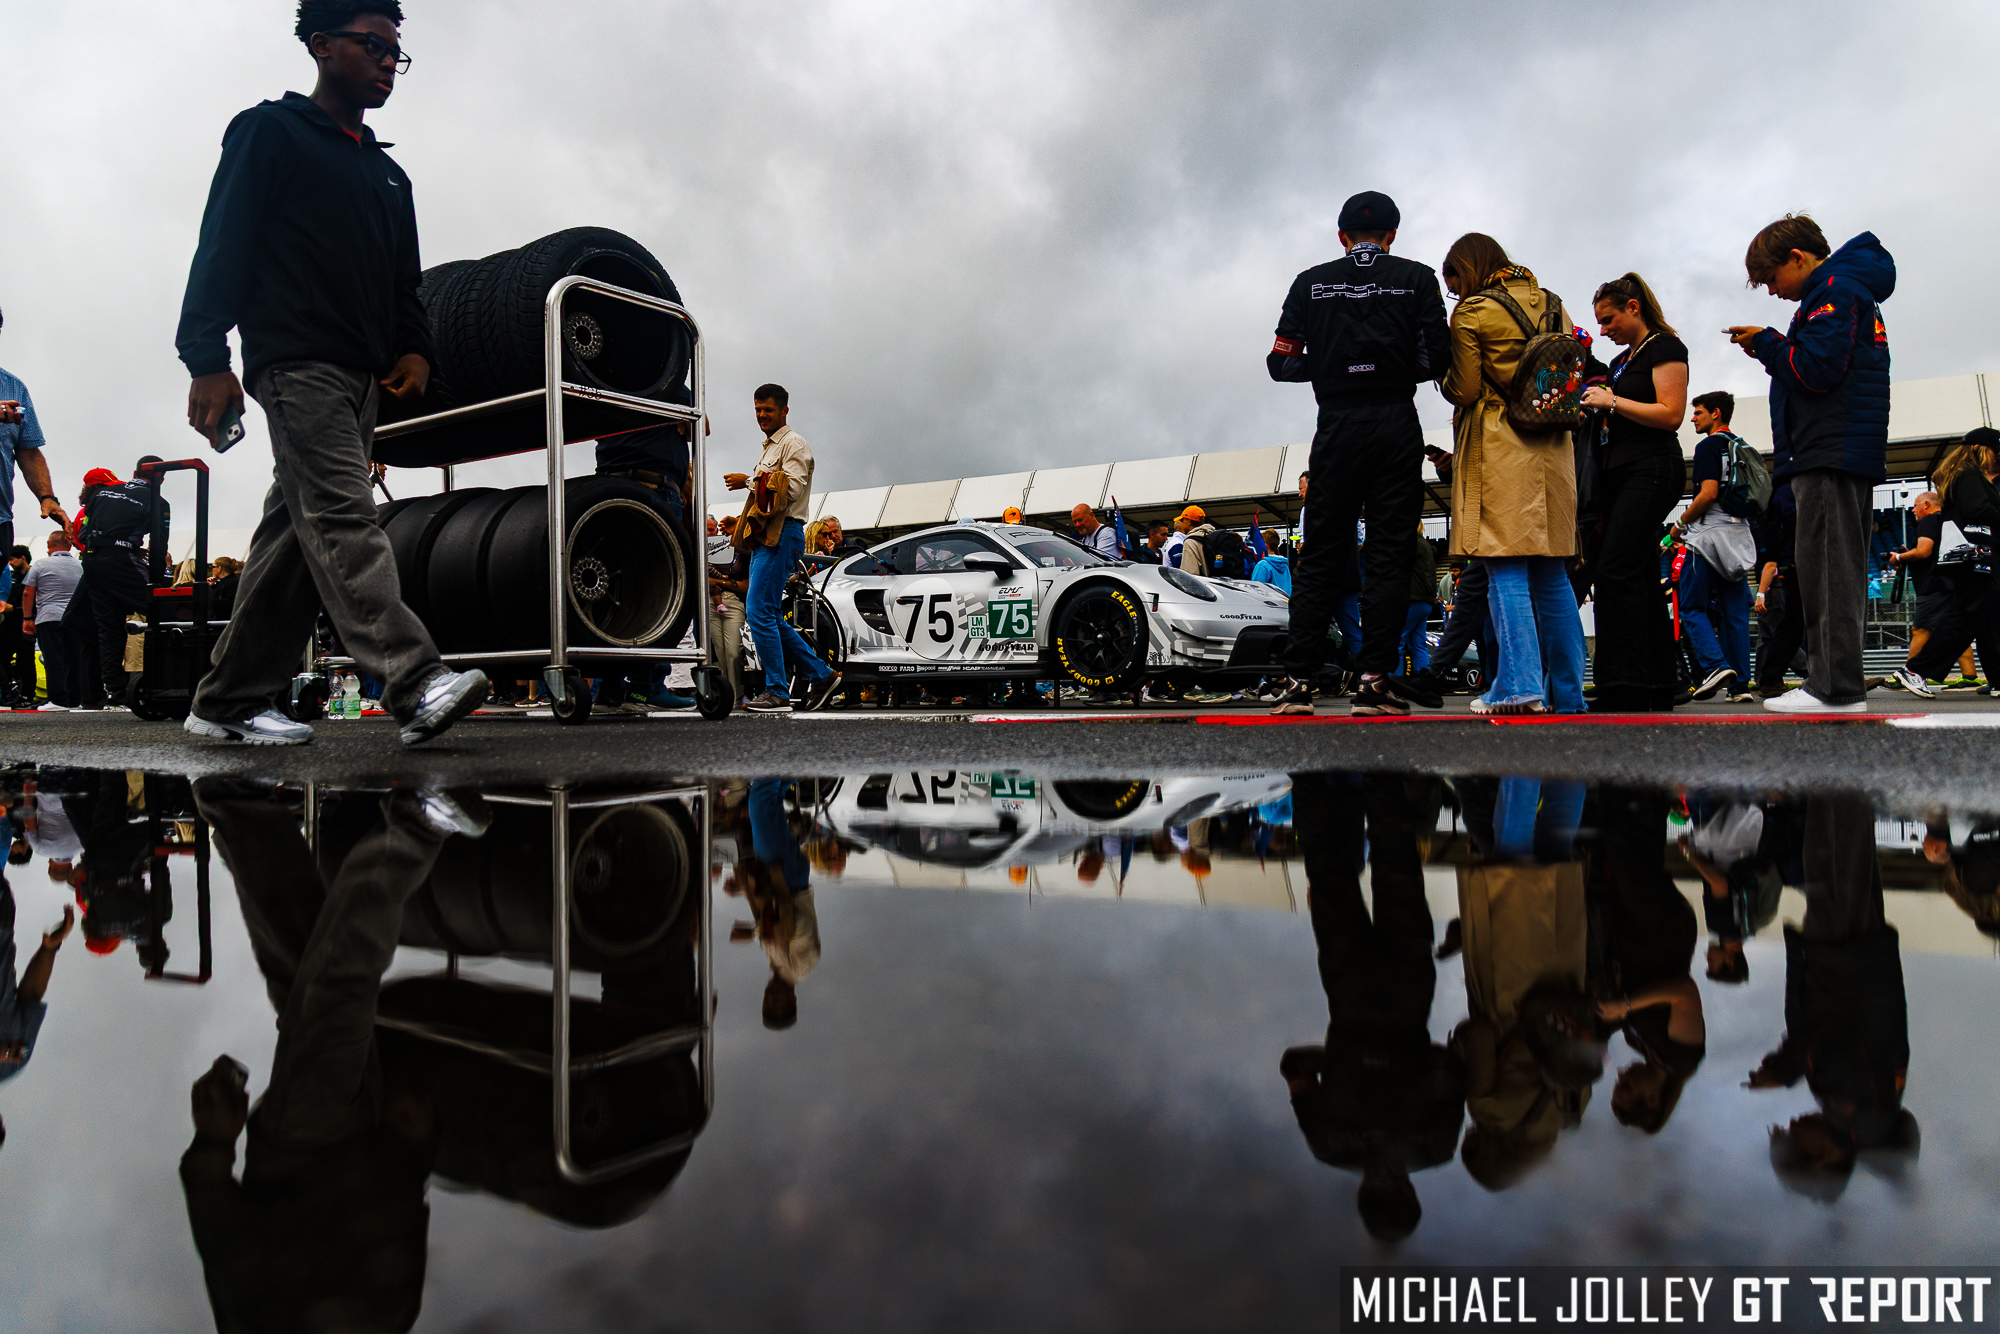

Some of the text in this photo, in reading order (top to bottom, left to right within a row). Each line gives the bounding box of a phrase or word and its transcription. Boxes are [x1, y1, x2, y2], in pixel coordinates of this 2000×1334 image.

[1348, 364, 1375, 372] sparco
[1111, 591, 1138, 618] EAGLE
[898, 593, 954, 643] 75
[972, 617, 982, 626] LM
[992, 603, 1029, 635] 75
[971, 627, 985, 636] GT3
[979, 643, 1034, 652] GOODYEAR
[1057, 638, 1100, 686] GOODYEAR
